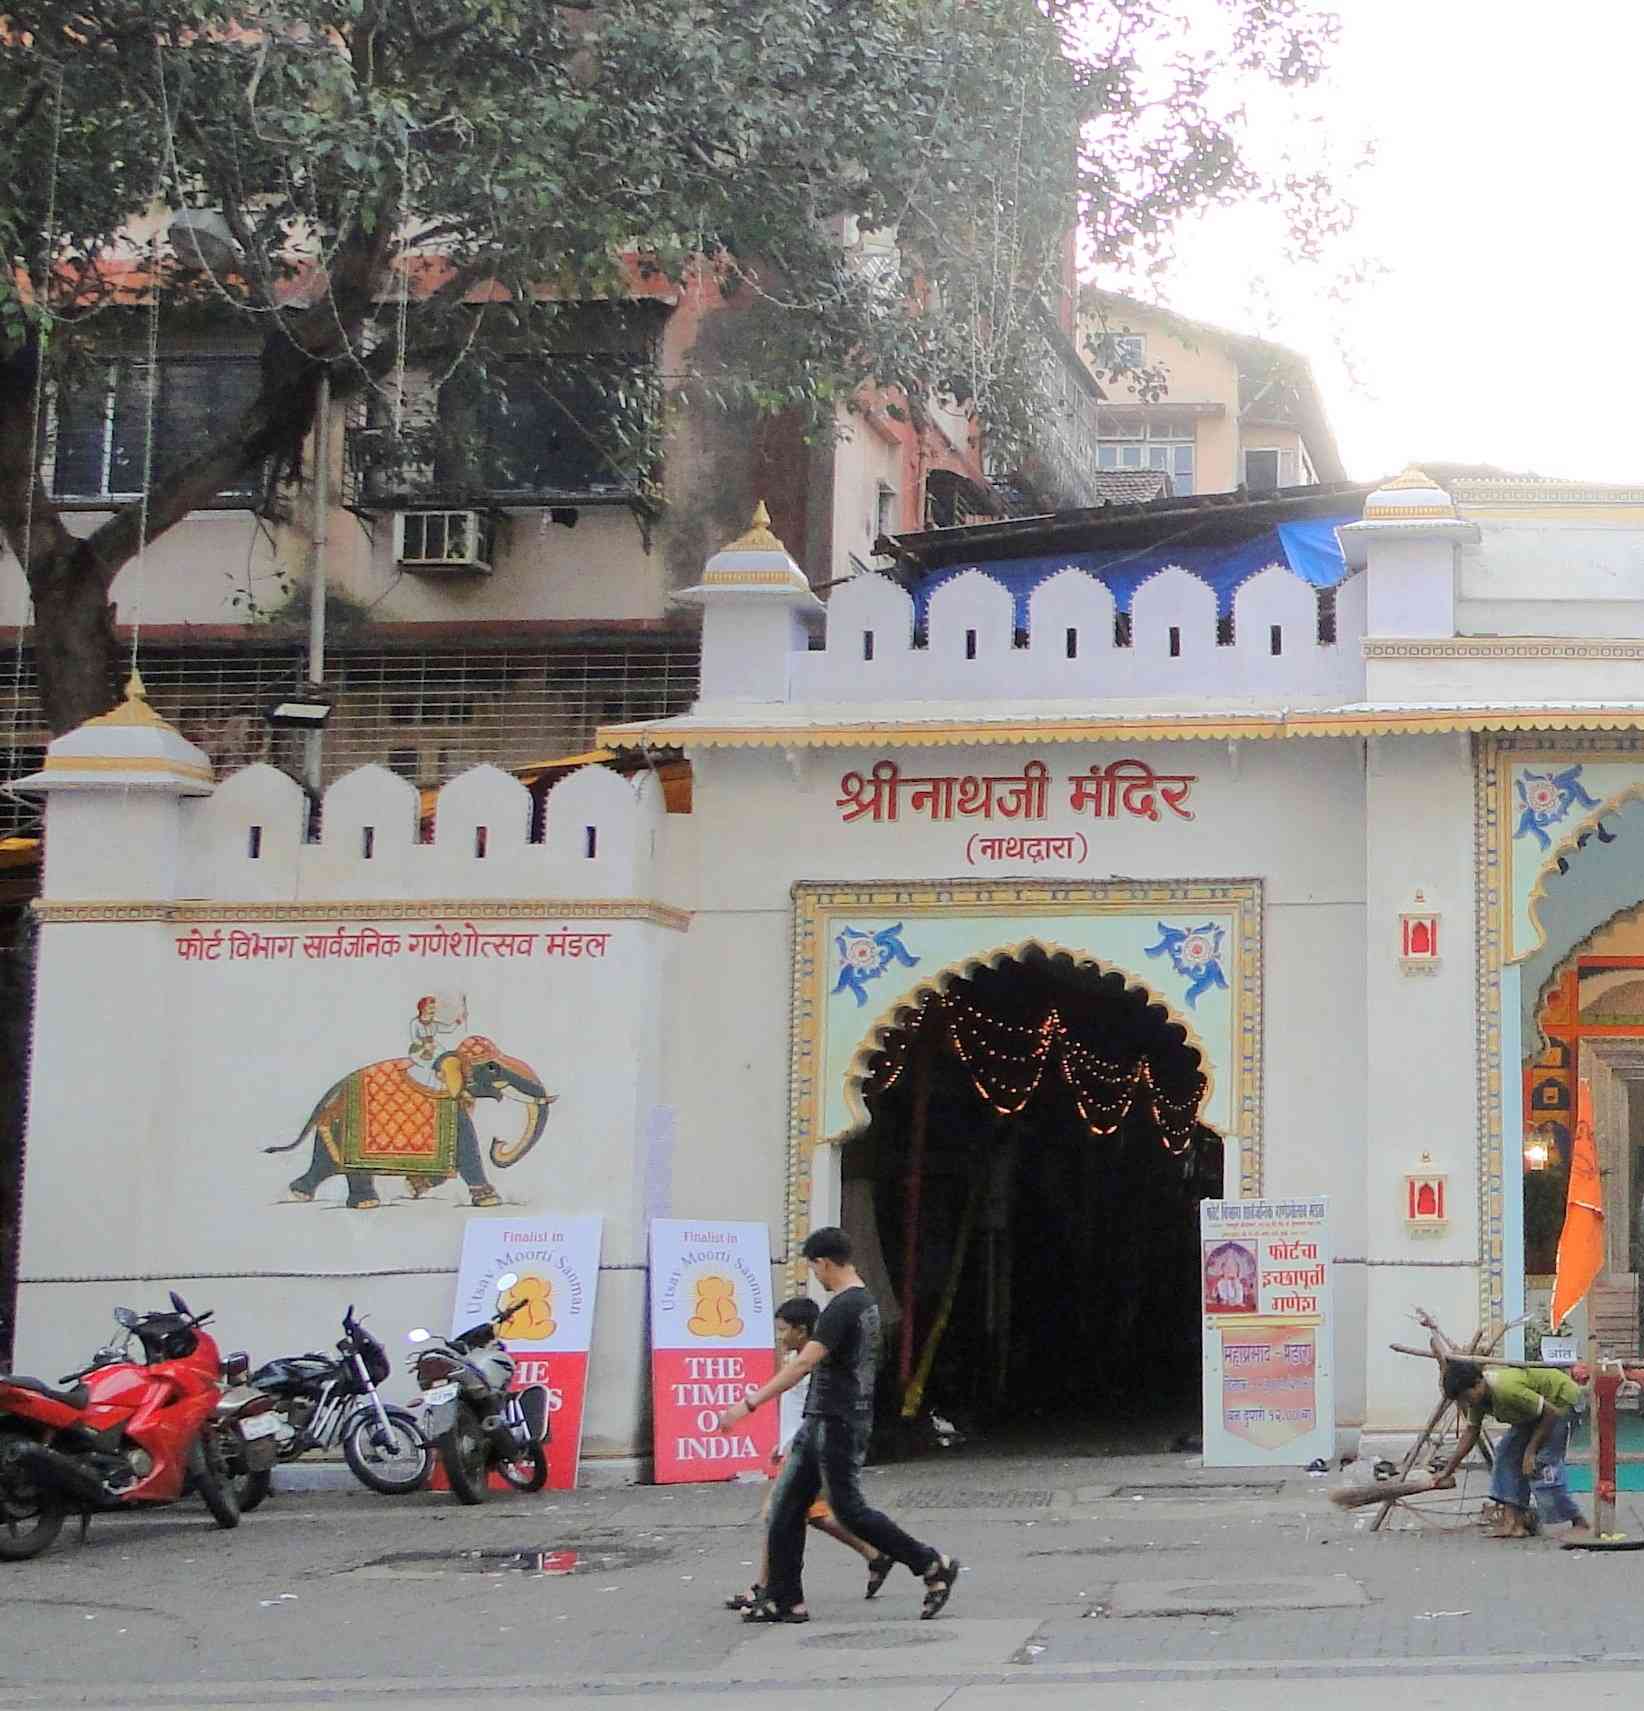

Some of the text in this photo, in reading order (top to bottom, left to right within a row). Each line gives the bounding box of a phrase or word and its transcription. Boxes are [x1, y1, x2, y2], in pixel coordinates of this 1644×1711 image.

[836, 759, 1199, 822] श्रीनाथजी मंदिर
[966, 832, 1089, 864] (नाथद्वारा)
[175, 922, 612, 961] फोर्ट विभाग सार्वजनिक गणेशोत्सव मंडल
[504, 1231, 564, 1242] Finalist in
[1268, 1239, 1318, 1260] फोर्टचा
[514, 1361, 550, 1384] HE
[685, 1357, 744, 1379] THE
[676, 1435, 758, 1460] INDIA
